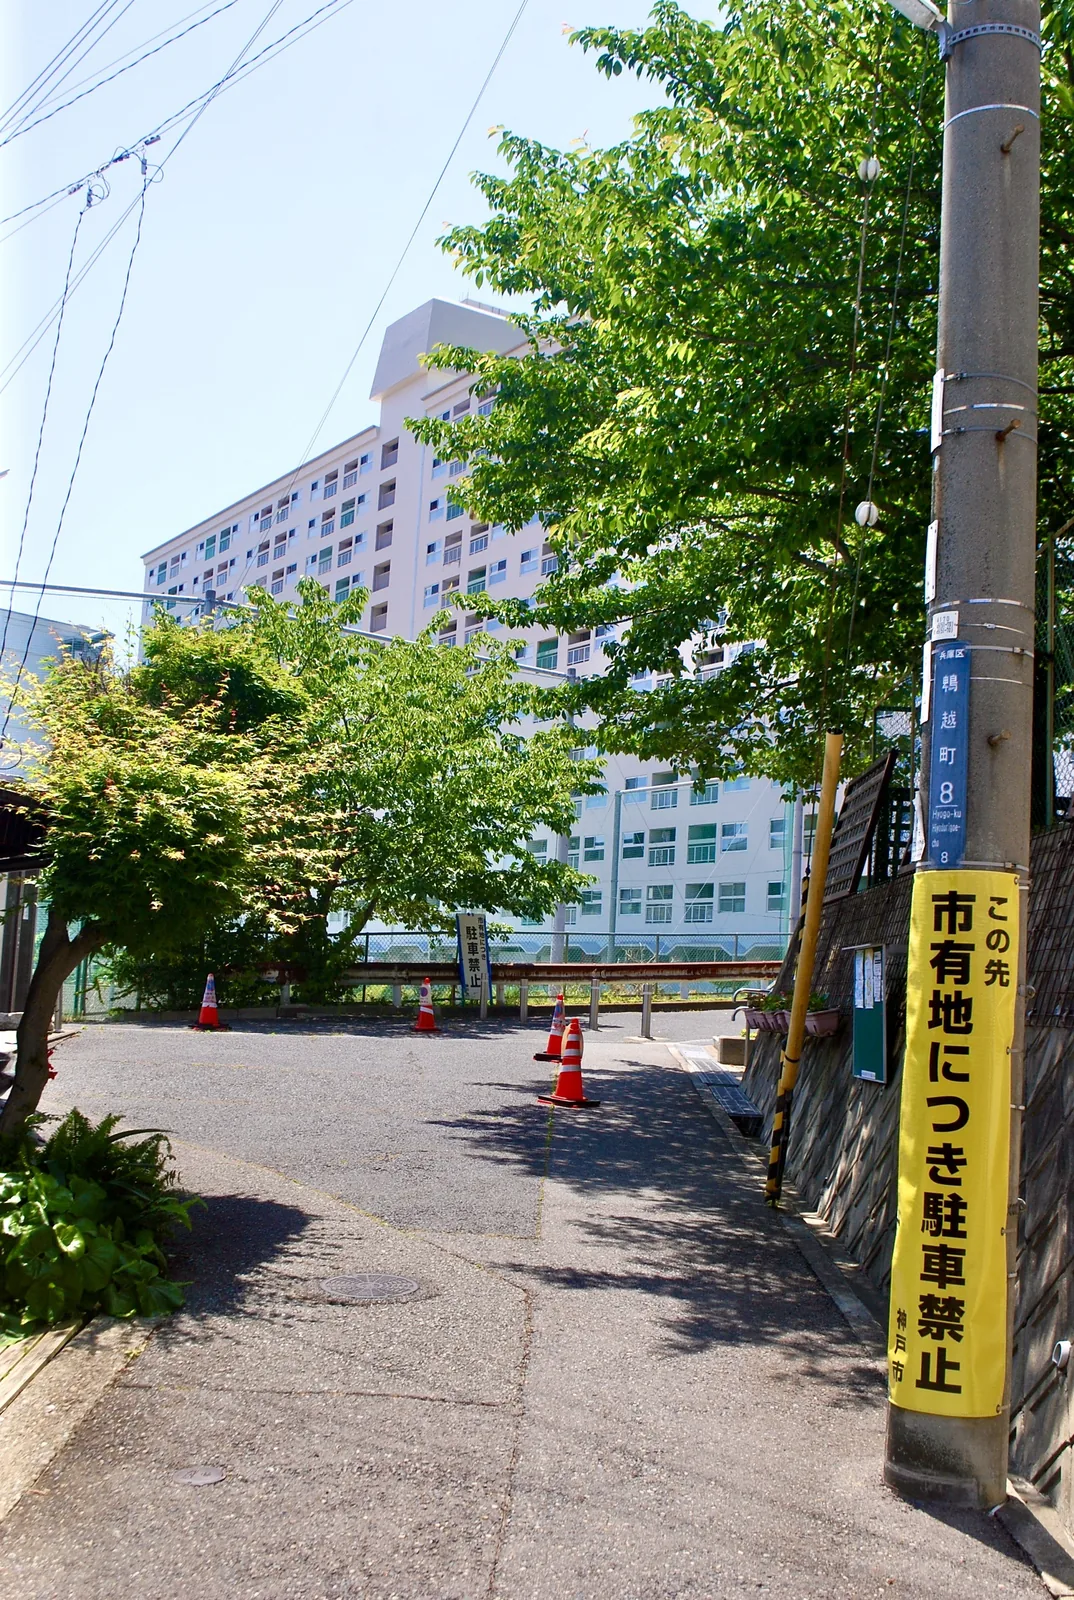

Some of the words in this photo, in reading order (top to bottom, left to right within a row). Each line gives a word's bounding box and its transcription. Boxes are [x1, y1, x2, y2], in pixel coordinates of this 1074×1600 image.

[939, 648, 965, 660] 兵庫区
[932, 809, 962, 820] Hyogo-ku
[939, 781, 954, 805] 8
[940, 851, 949, 864] 8
[465, 925, 481, 988] 駐車禁止
[984, 895, 1011, 989] この先
[915, 889, 977, 1395] 市有地につき駐車禁止
[891, 1307, 908, 1383] 神戸市
